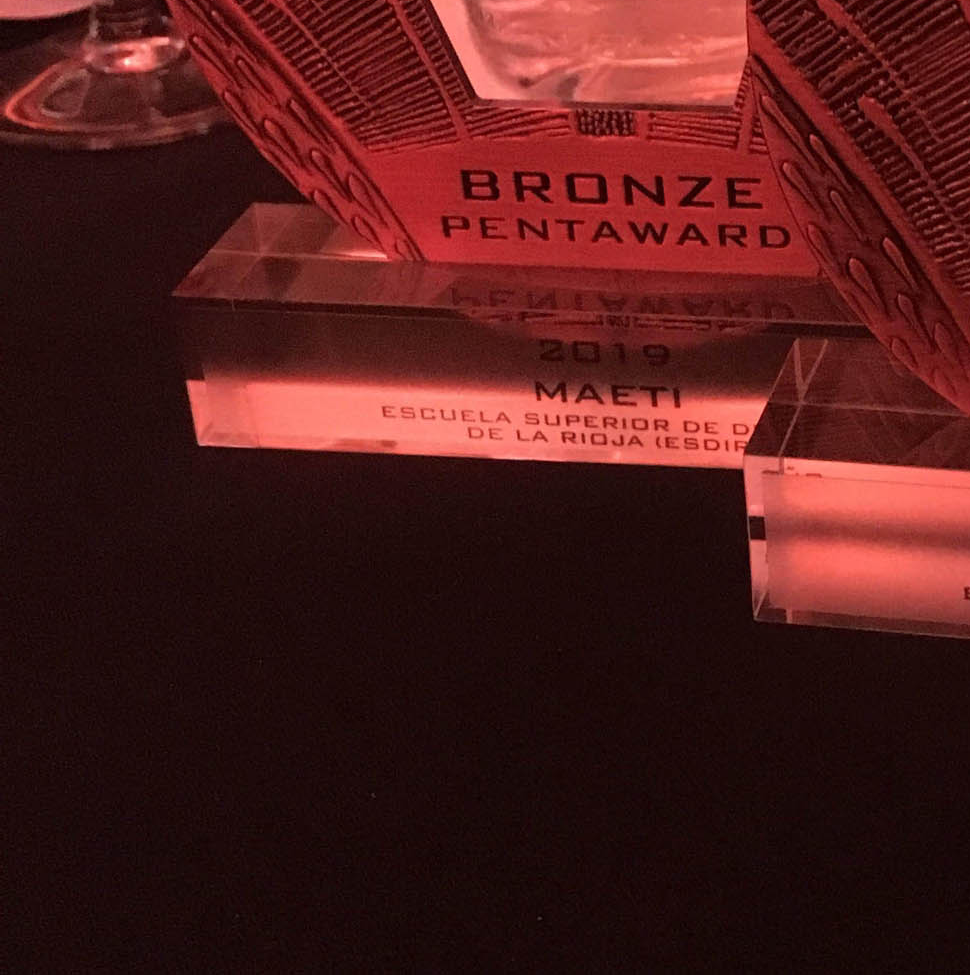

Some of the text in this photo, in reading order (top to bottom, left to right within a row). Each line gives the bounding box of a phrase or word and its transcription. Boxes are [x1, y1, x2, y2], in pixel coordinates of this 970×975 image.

[460, 169, 764, 210] BRONZE
[441, 215, 791, 250] PENTAWARD
[538, 338, 671, 366] 2019
[535, 380, 682, 408] MAETI
[382, 405, 512, 424] ESCUELA
[524, 412, 670, 432] SUPERIOR
[683, 420, 720, 435] DE
[467, 426, 504, 441] DE
[516, 428, 549, 443] LA
[560, 430, 645, 449] RIOJA
